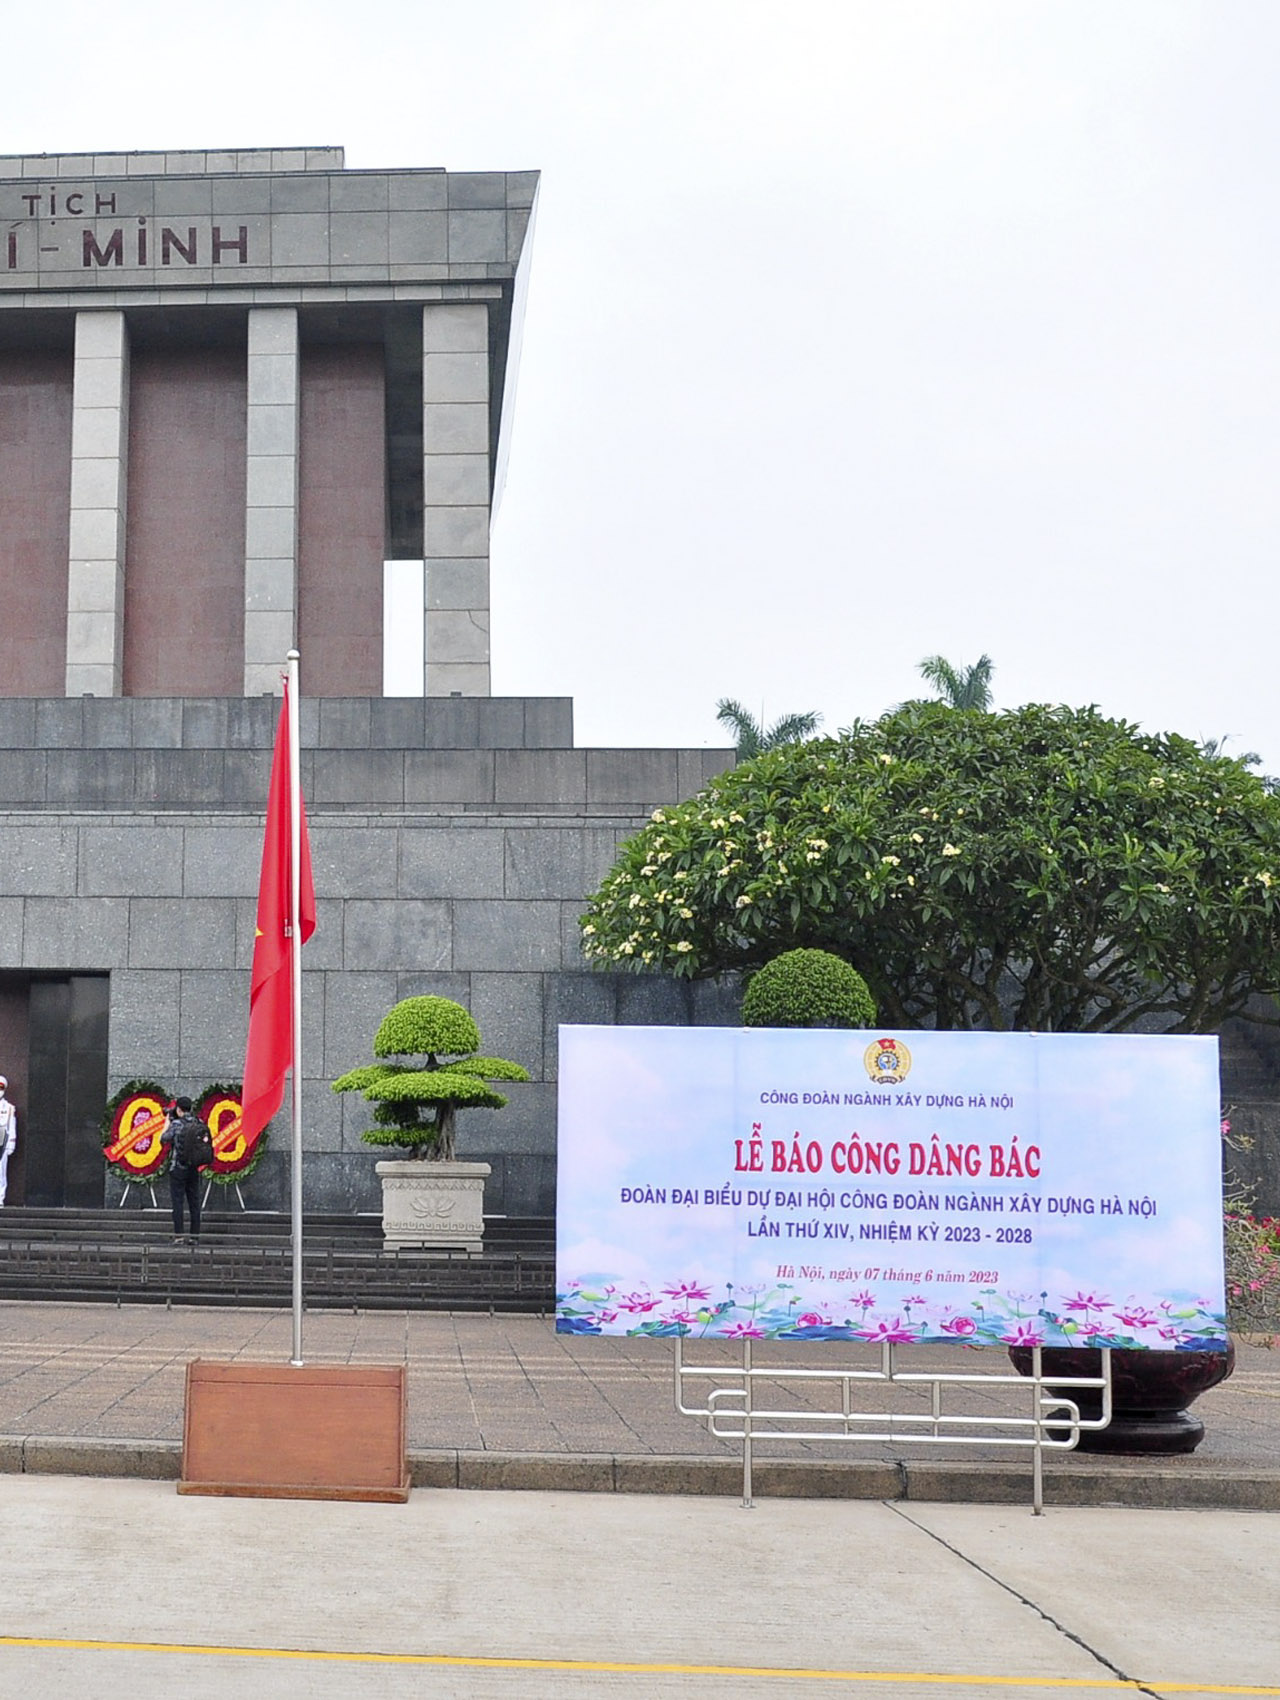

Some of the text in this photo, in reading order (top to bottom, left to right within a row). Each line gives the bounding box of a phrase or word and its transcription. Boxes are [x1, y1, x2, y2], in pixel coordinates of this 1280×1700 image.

[760, 1089, 1013, 1110] CÔNG ĐOÀN NGÀNH XÂY DỰNG HÀ NỘI
[734, 1122, 1040, 1178] LỄ BÁO CÔNG DÂNG BÁC
[621, 1182, 1157, 1219] ĐOÀN ĐẠI BIỂU DỰ ĐẠI HỘI CÔNG ĐOÀN NGÀNH XÂY DỰNG HÀ NỘI
[785, 1218, 819, 1238] THỨ
[823, 1223, 854, 1241] XIV,
[859, 1220, 911, 1243] NHIỆM
[918, 1221, 939, 1241] KỲ
[945, 1227, 981, 1242] 2023
[996, 1228, 1032, 1243] 2028
[776, 1265, 998, 1284] Hà Nội, ngày 07 tháng 6 năm 2023
